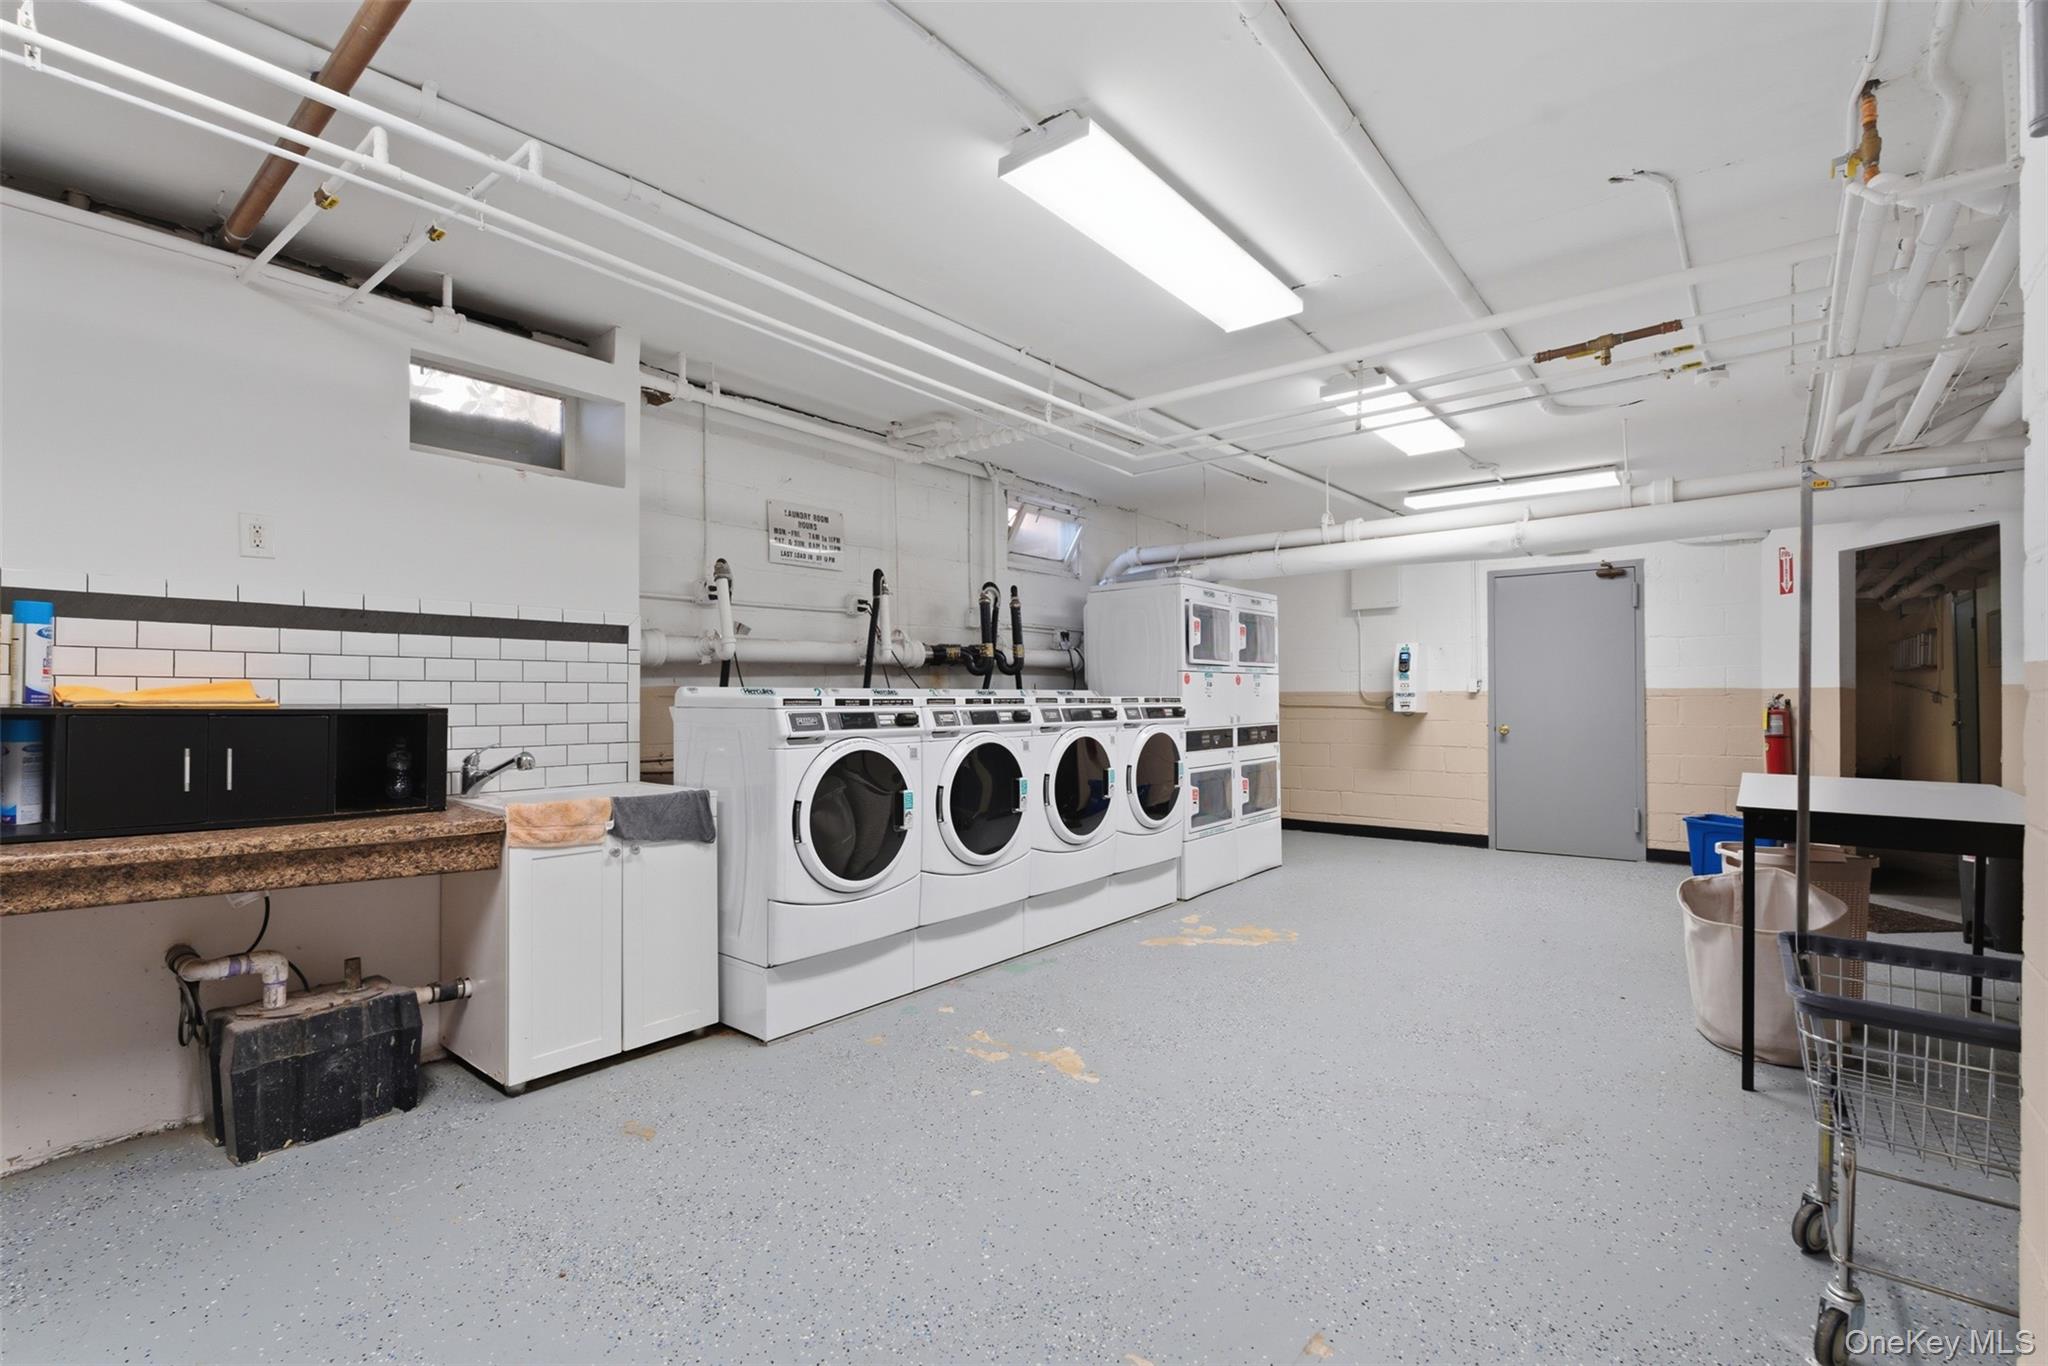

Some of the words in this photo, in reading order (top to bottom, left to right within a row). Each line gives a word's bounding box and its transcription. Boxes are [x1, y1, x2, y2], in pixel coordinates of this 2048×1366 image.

[784, 509, 811, 520] LAUNDRY
[813, 514, 829, 523] ROOM
[798, 521, 817, 530] HOURS
